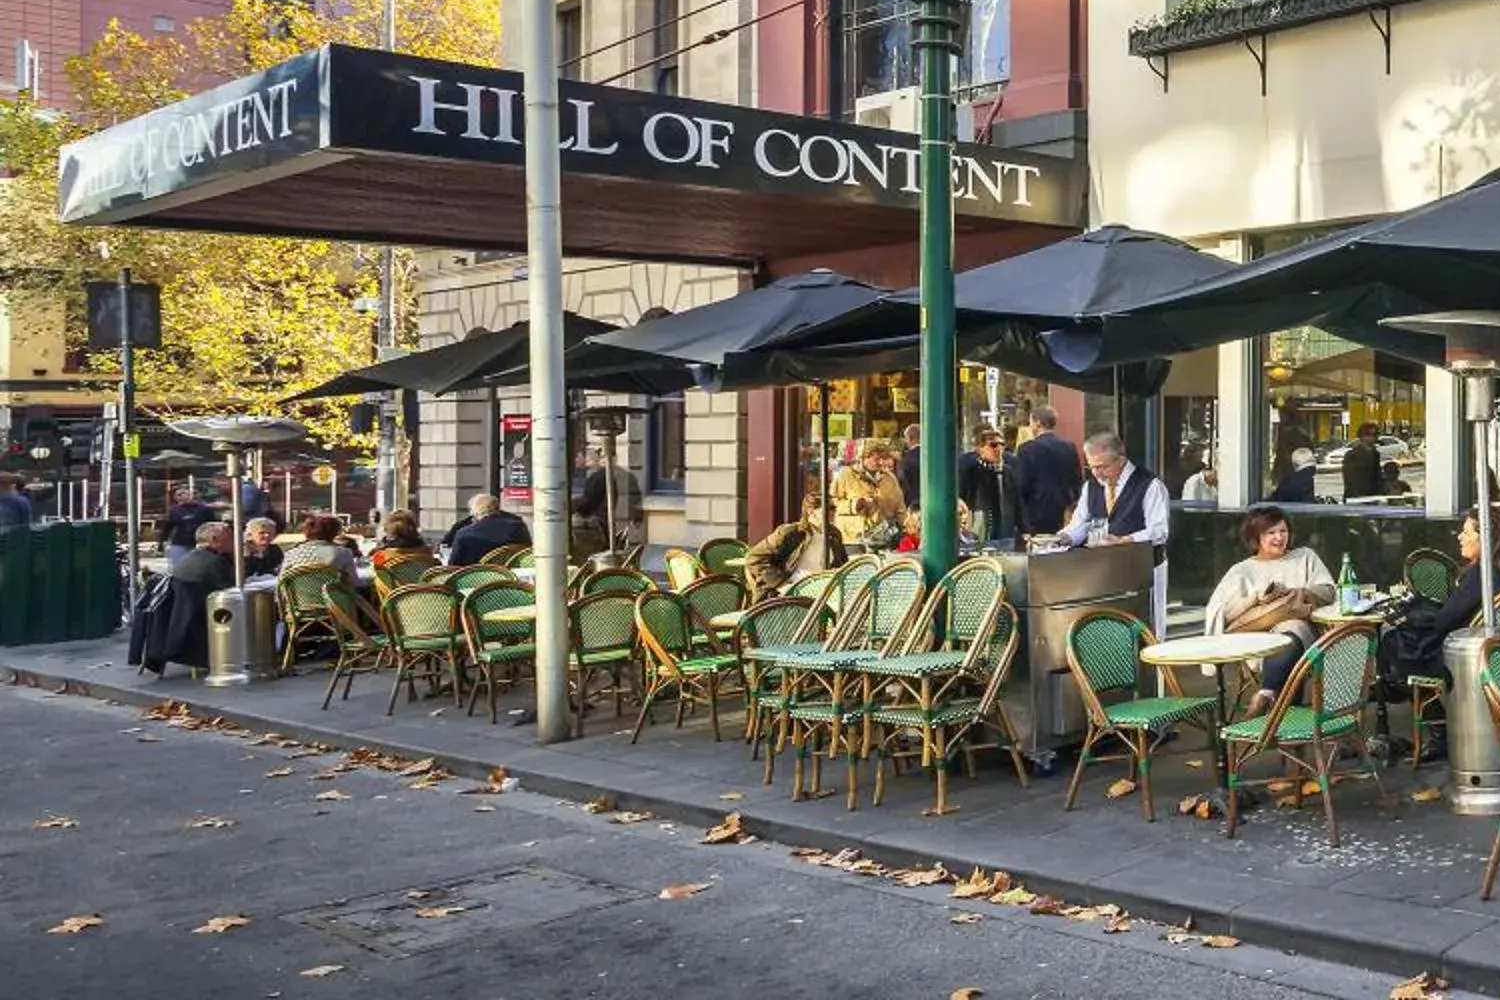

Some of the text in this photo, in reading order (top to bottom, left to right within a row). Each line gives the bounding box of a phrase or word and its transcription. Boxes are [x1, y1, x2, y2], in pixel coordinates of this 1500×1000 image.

[163, 77, 298, 172] CONTENT
[407, 74, 619, 156] HIL
[642, 112, 734, 169] OF
